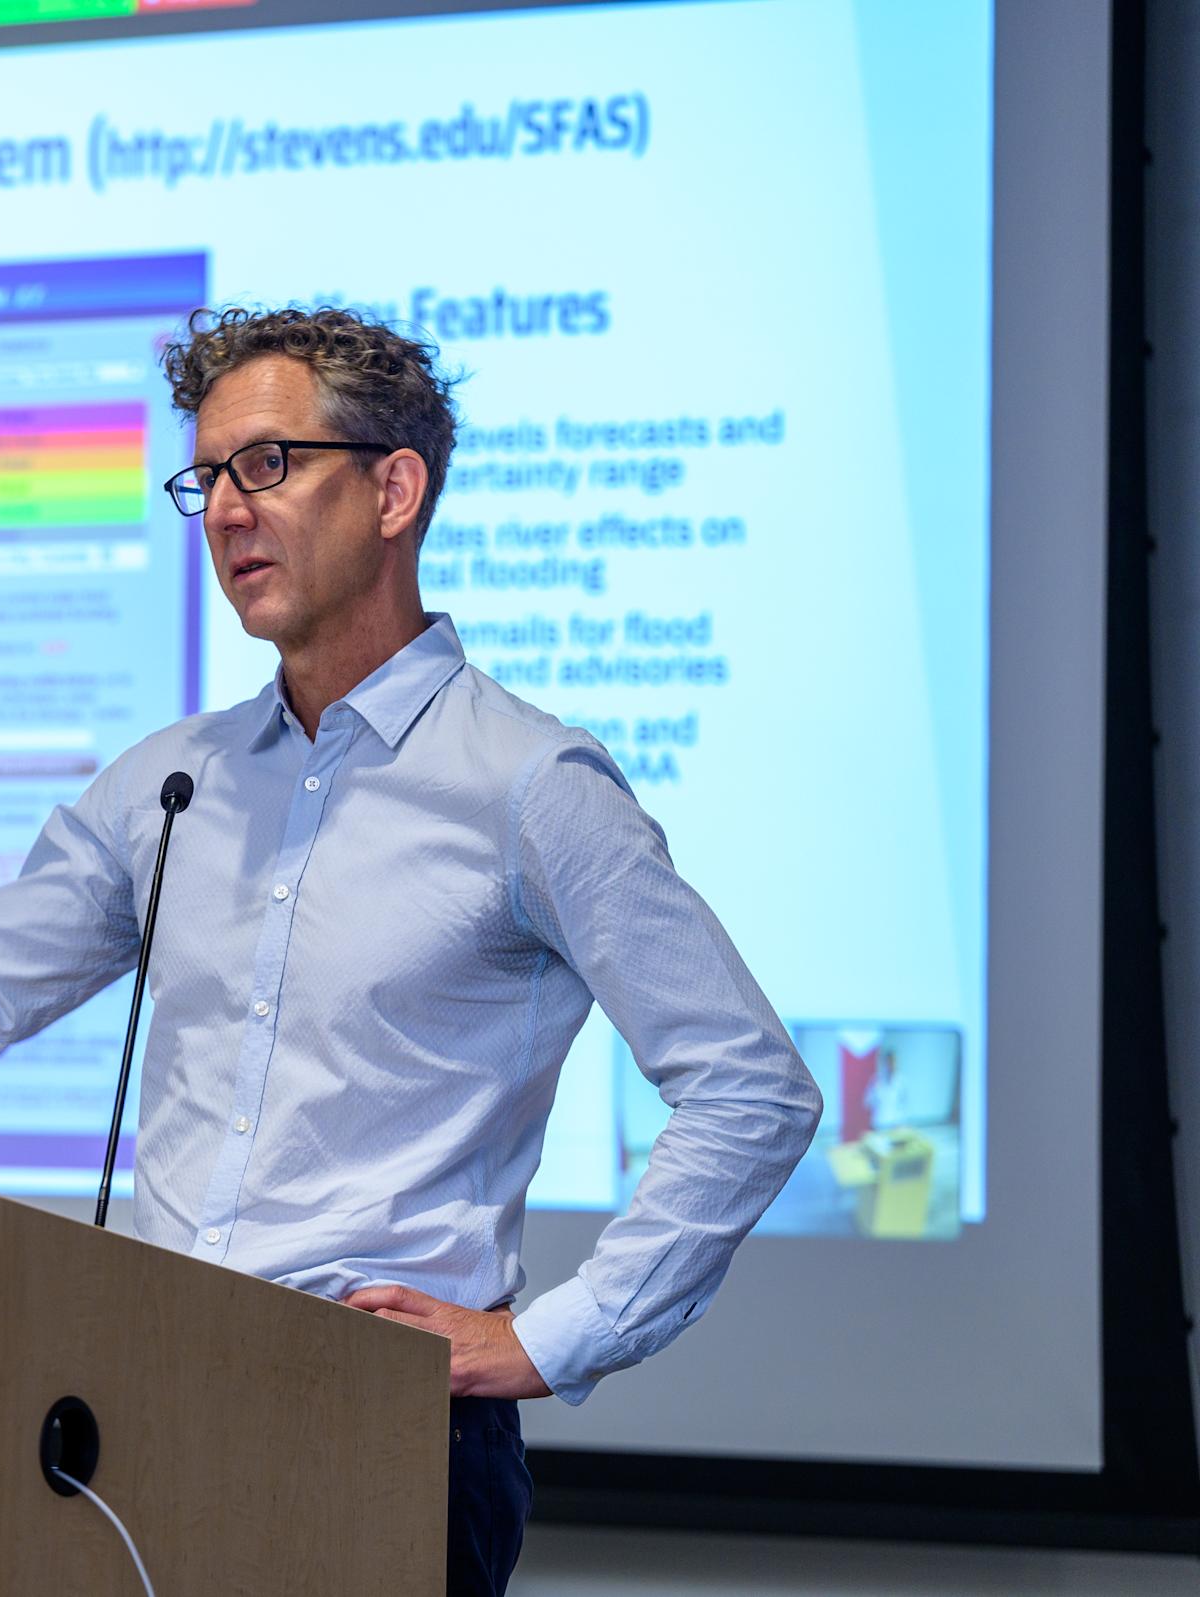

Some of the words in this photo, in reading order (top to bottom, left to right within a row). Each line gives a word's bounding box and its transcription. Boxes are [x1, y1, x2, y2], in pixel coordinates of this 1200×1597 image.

[88, 92, 649, 190] (http://stevens.edu/SFAS)
[409, 288, 610, 341] Features
[457, 419, 546, 452] evels
[556, 412, 710, 449] forecasts
[718, 408, 784, 446] and
[448, 458, 580, 496] ertainty
[588, 458, 685, 495] range
[496, 517, 569, 549] river
[577, 513, 694, 549] effects
[701, 516, 747, 546] on
[471, 557, 606, 595] flooding
[569, 613, 614, 646] for
[624, 610, 712, 646] flood
[491, 656, 551, 687] and
[558, 655, 730, 687] advisories
[634, 710, 698, 747] and
